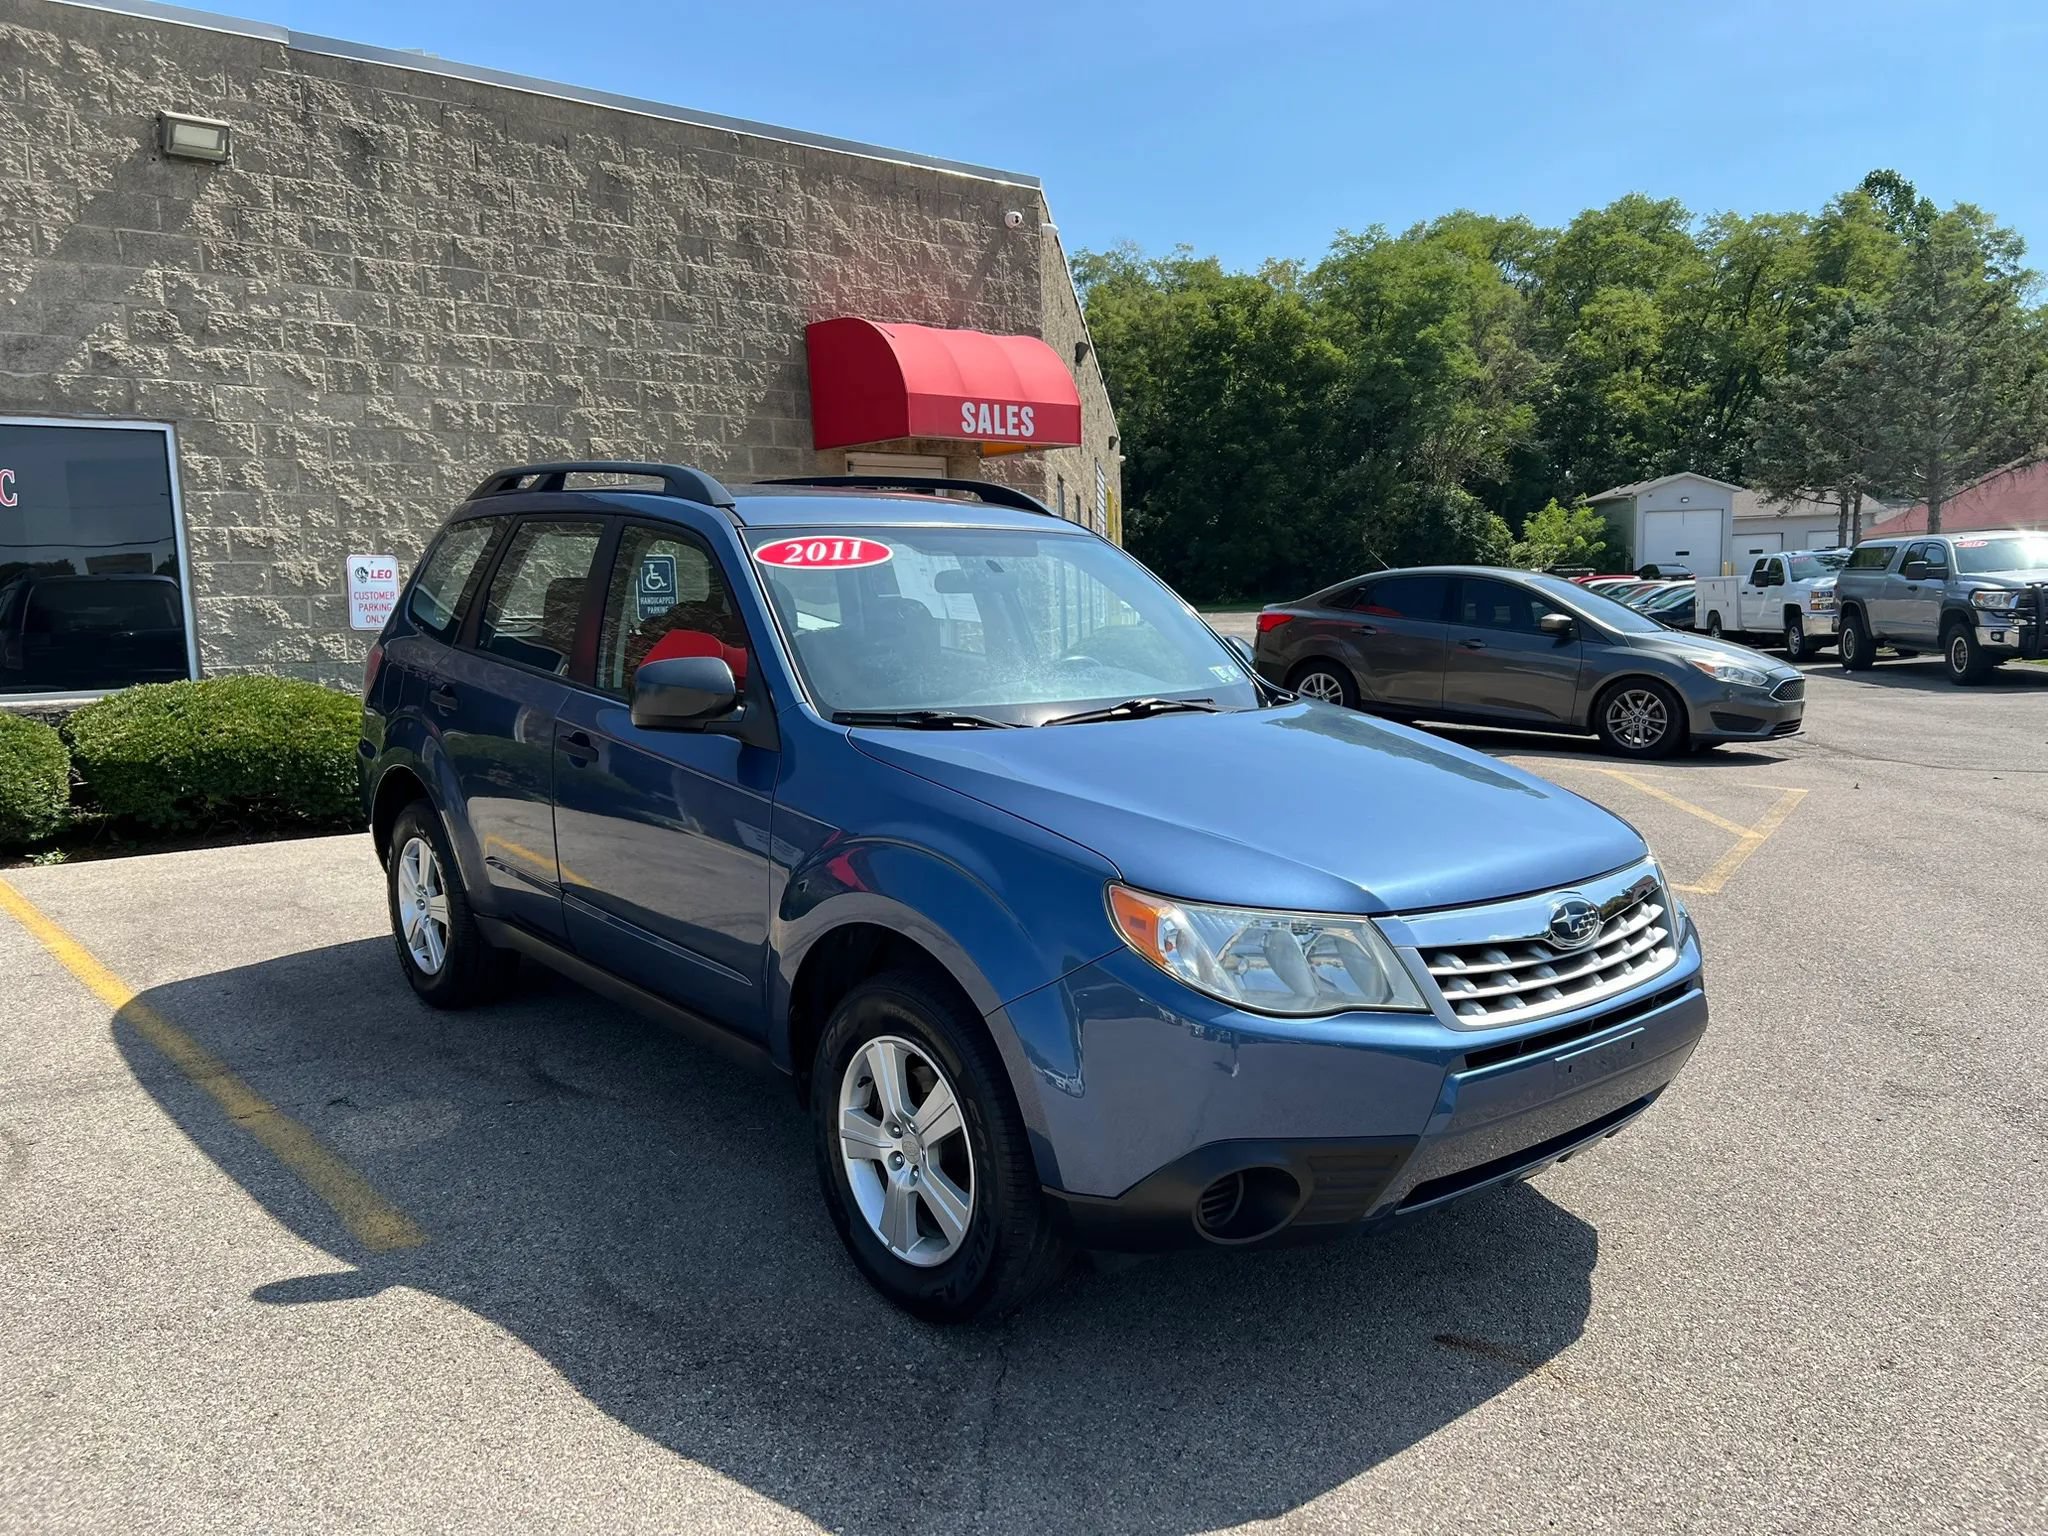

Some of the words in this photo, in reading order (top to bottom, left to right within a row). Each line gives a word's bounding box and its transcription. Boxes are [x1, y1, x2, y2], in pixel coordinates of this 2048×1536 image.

[961, 402, 1034, 437] SALES
[783, 541, 862, 563] 2011
[371, 570, 392, 579] LEO
[354, 592, 395, 600] CUSTOMER
[640, 596, 675, 605] HANDICAPPED
[359, 604, 392, 612] PARKING
[366, 615, 386, 623] ONLY
